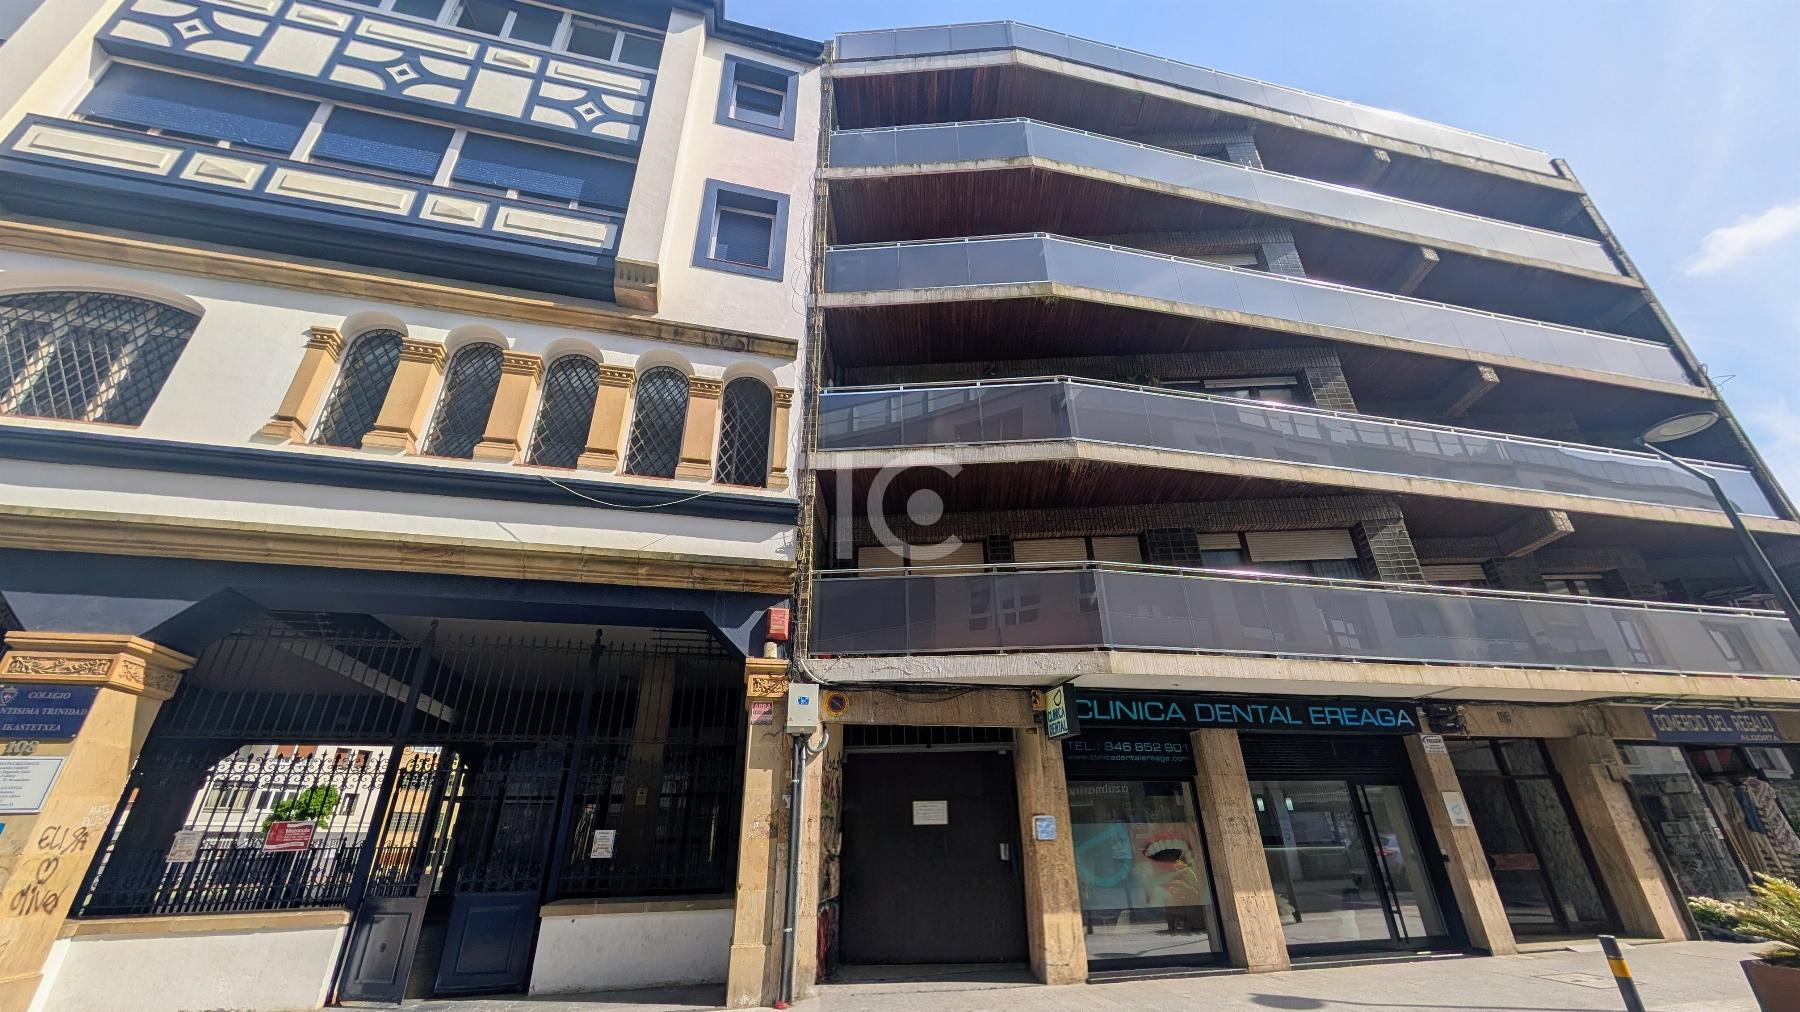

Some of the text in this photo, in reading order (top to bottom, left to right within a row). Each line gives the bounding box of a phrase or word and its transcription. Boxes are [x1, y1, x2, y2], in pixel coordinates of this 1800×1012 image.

[28, 691, 72, 700] COLEGIO
[41, 708, 88, 716] TRINIDAD
[1076, 699, 1415, 727] CLINICA DENTAL EREAGA
[2, 723, 61, 732] IKASTETXEA
[1048, 718, 1069, 735] DENTAL
[1652, 714, 1774, 732] COMERCIO DEL REGALO
[1104, 741, 1132, 752] 946
[1135, 742, 1162, 753] 852
[1164, 743, 1189, 754] 901
